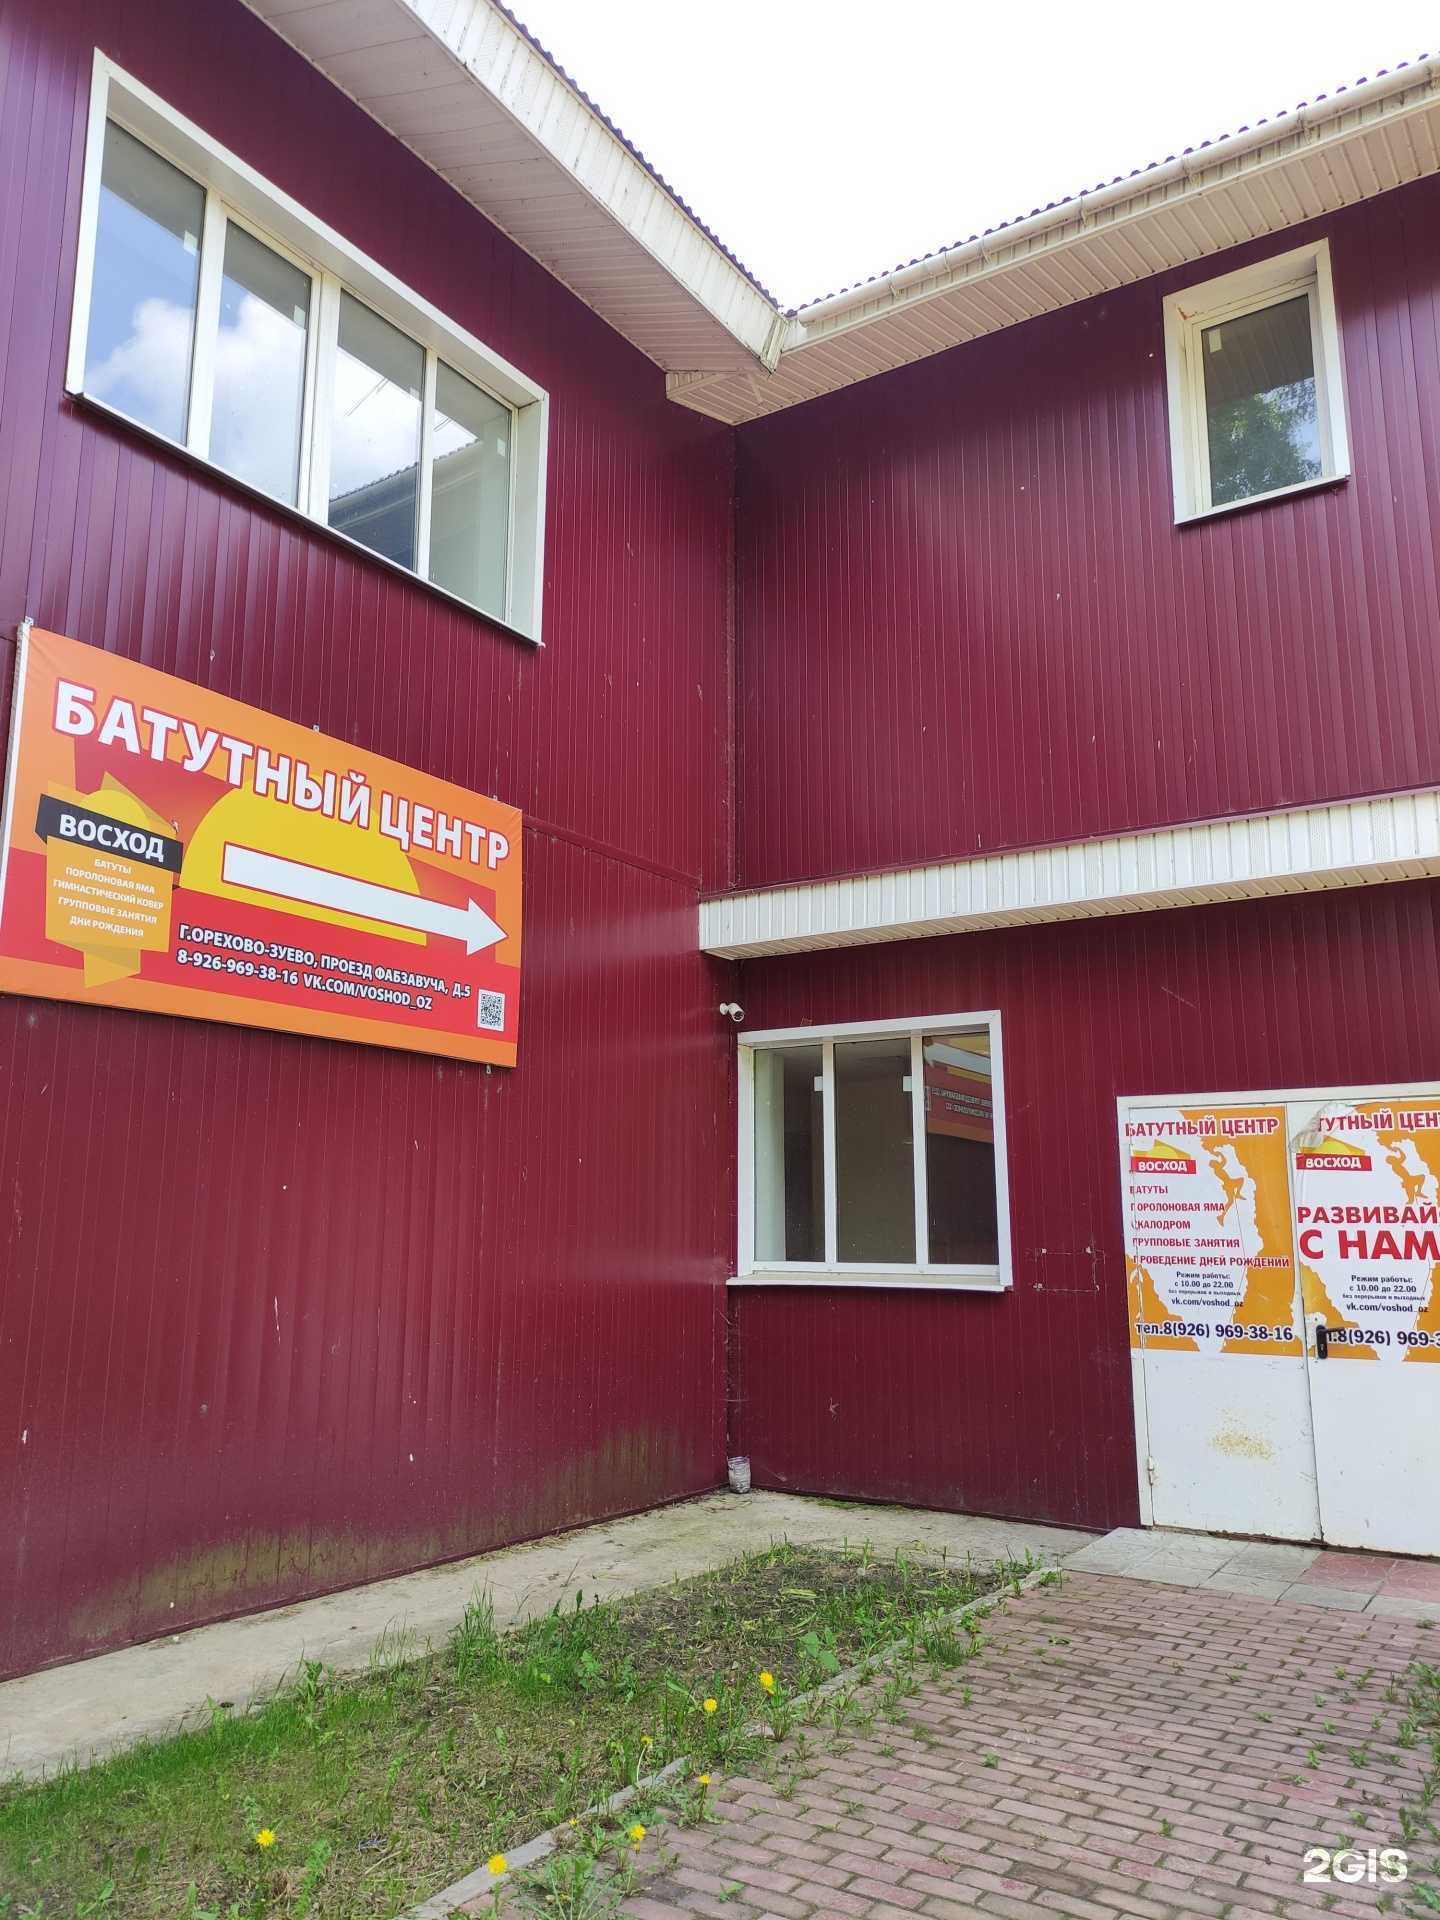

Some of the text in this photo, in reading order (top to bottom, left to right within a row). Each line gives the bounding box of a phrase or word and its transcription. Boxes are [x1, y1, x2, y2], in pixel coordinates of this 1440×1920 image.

[54, 679, 509, 870] БАТУТНЫЙ ЦЕНТР
[60, 814, 164, 862] ВОСХОД
[94, 859, 131, 874] БАТУТЫ
[65, 867, 155, 894] ПОРОЛОНОВАЯ ЯМА
[53, 880, 164, 910] ГИМНАСТИЧЕСКИЙ КОВЕР
[58, 896, 157, 924] ГРУППОВЫЕ ЗАНЯТИЯ
[70, 915, 144, 937] ДНИ РОЖДЕНИЯ
[179, 924, 471, 998] Г.ОРЕХОВО-ЗУЕВО, ПРОЕЗД ФАБЗАВУЧА, Д.5
[176, 948, 433, 1010] 8-926-969-38-16 VK.COM/VOSHOD_OZ
[1125, 1117, 1278, 1137] БАТУТНЫЙ ЦЕНТР
[1318, 1110, 1440, 1131] ТУТНЫЙ ЦЕН
[1138, 1161, 1187, 1172] ВОСХОД
[1305, 1157, 1361, 1168] ВОСХОД
[1203, 1203, 1225, 1211] ЯМА
[1297, 1202, 1440, 1224] РАЗВИВАЙ
[1194, 1238, 1240, 1248] ЗАНЯТИЯ
[1299, 1229, 1324, 1260] С
[1199, 1255, 1226, 1267] ДНЕЙ
[1176, 1271, 1230, 1281] Режим работы:
[1181, 1280, 1201, 1288] 10.00
[1213, 1281, 1234, 1289] 22.00
[1351, 1274, 1413, 1284] Режим работы:
[1393, 1285, 1417, 1293] 22.00
[1136, 1322, 1293, 1341] тел.8(926) 969-38-16
